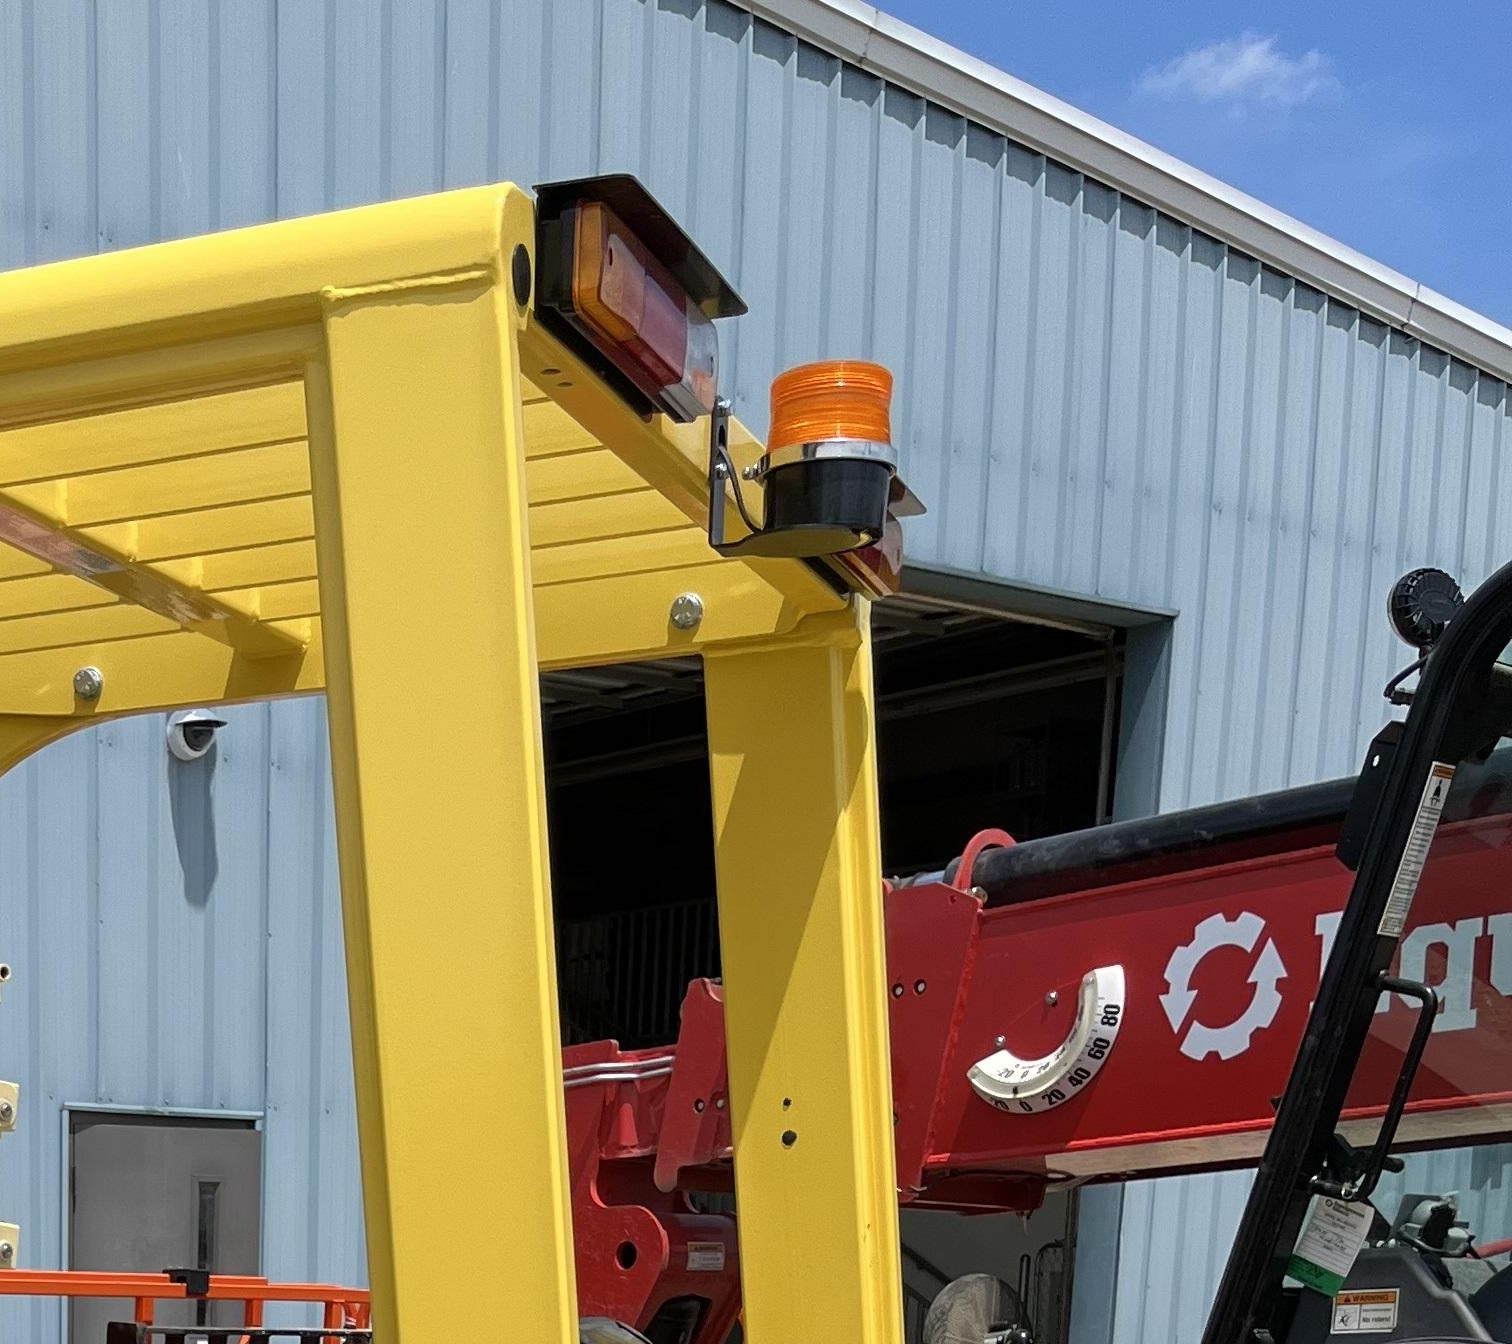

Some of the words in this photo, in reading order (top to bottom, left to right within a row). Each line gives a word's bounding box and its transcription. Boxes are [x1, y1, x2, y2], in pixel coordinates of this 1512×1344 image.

[1101, 1004, 1120, 1027] 80
[1088, 1037, 1110, 1060] 60
[1067, 1067, 1091, 1087] 40
[1020, 1102, 1032, 1112] 0
[1042, 1089, 1065, 1106] 20
